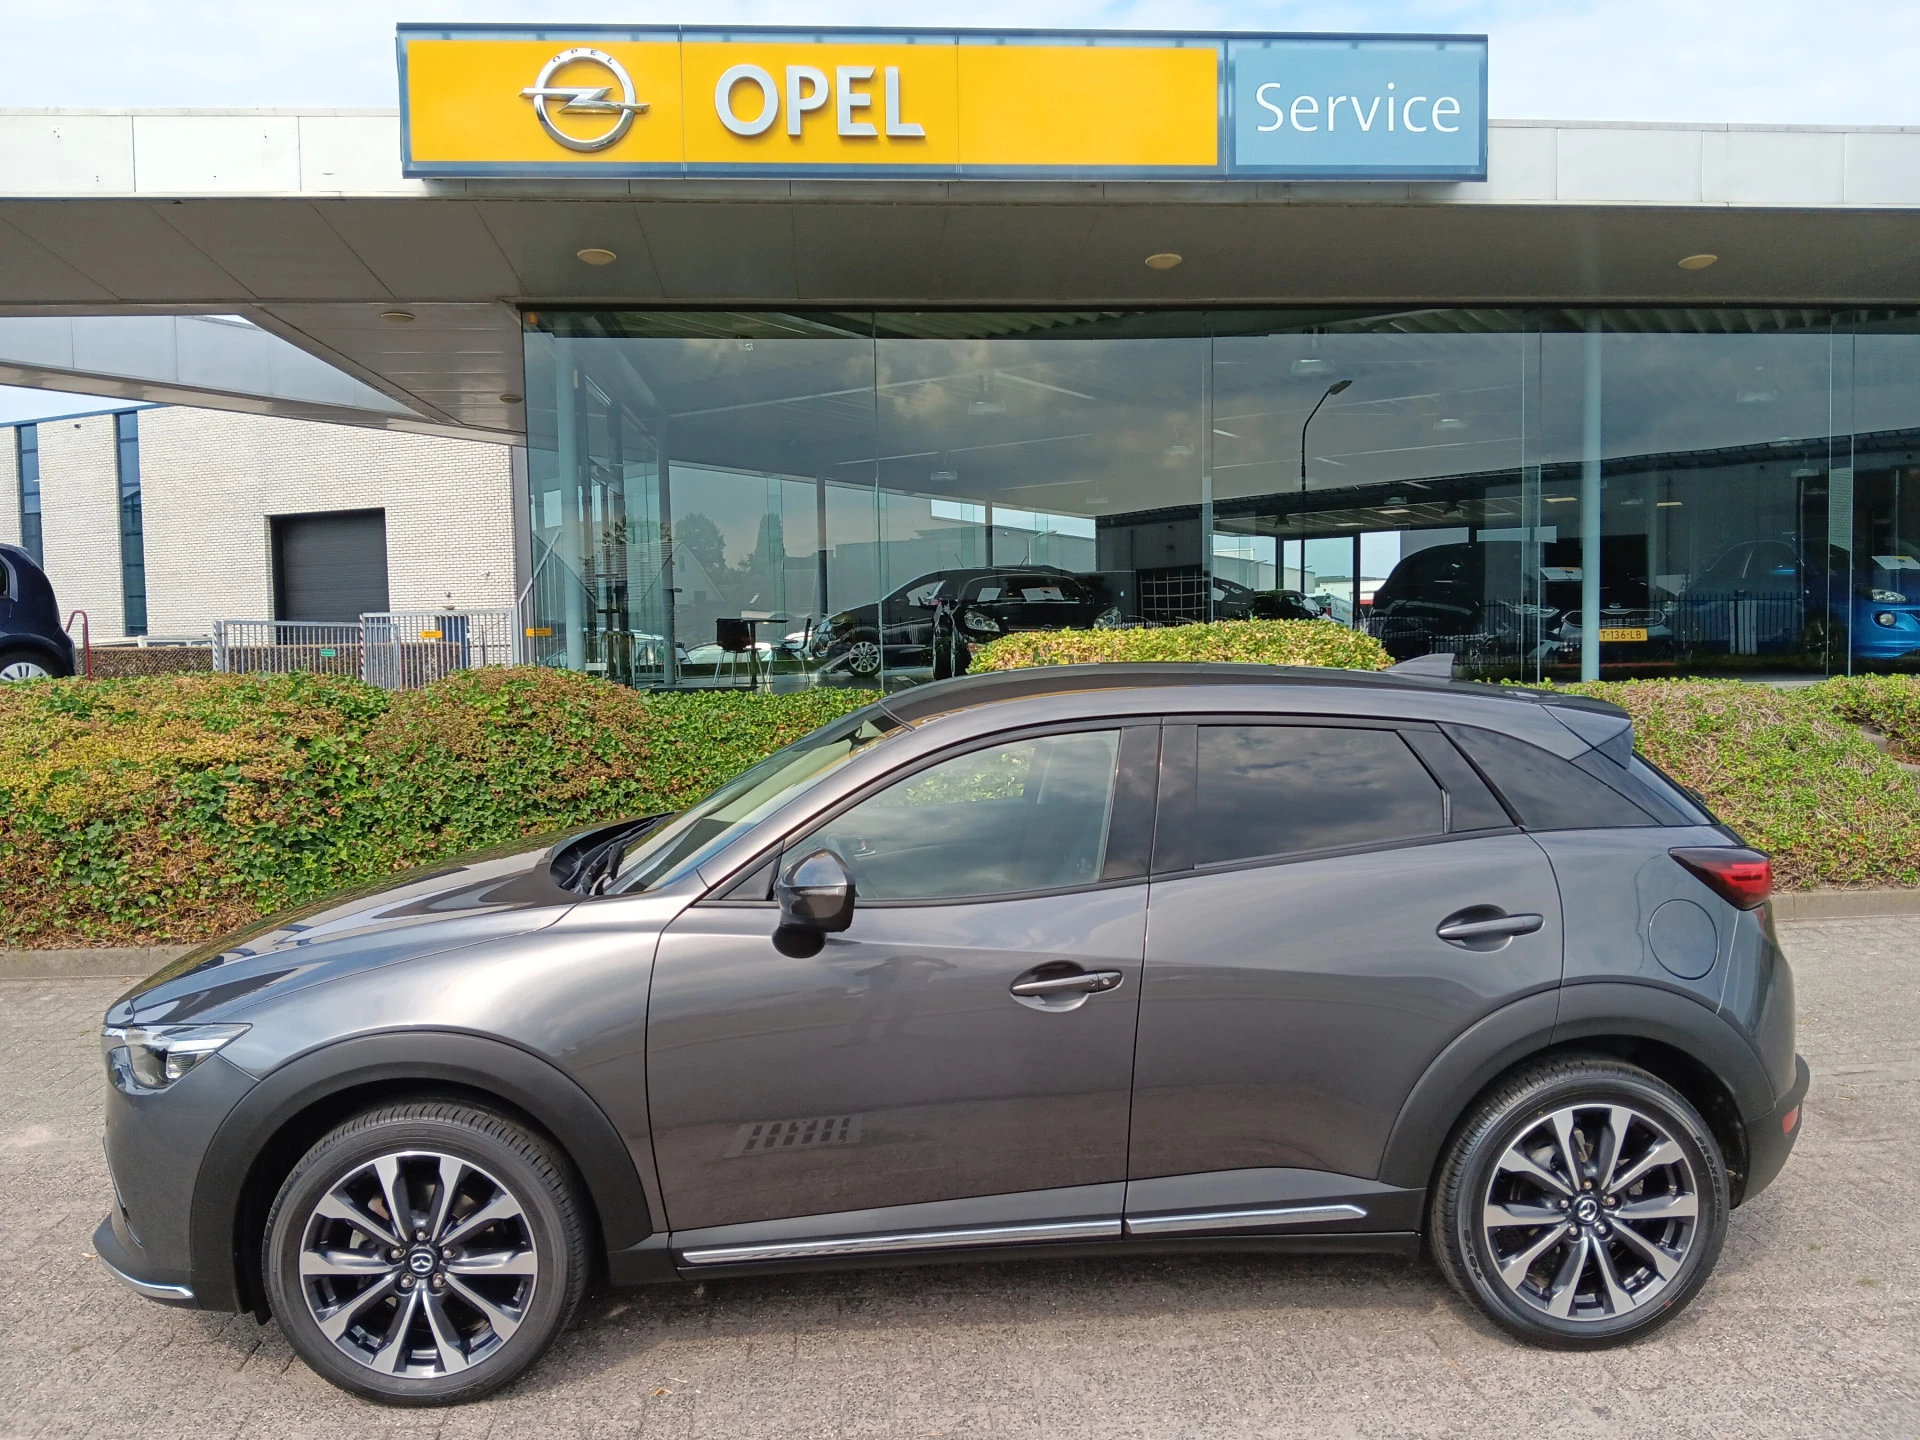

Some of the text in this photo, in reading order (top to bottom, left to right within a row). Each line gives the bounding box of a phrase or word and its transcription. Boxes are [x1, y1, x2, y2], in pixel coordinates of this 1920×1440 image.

[552, 48, 613, 65] OPEL
[715, 64, 925, 137] OPEL
[1255, 82, 1461, 132] Service
[1600, 630, 1642, 640] T-136-LB
